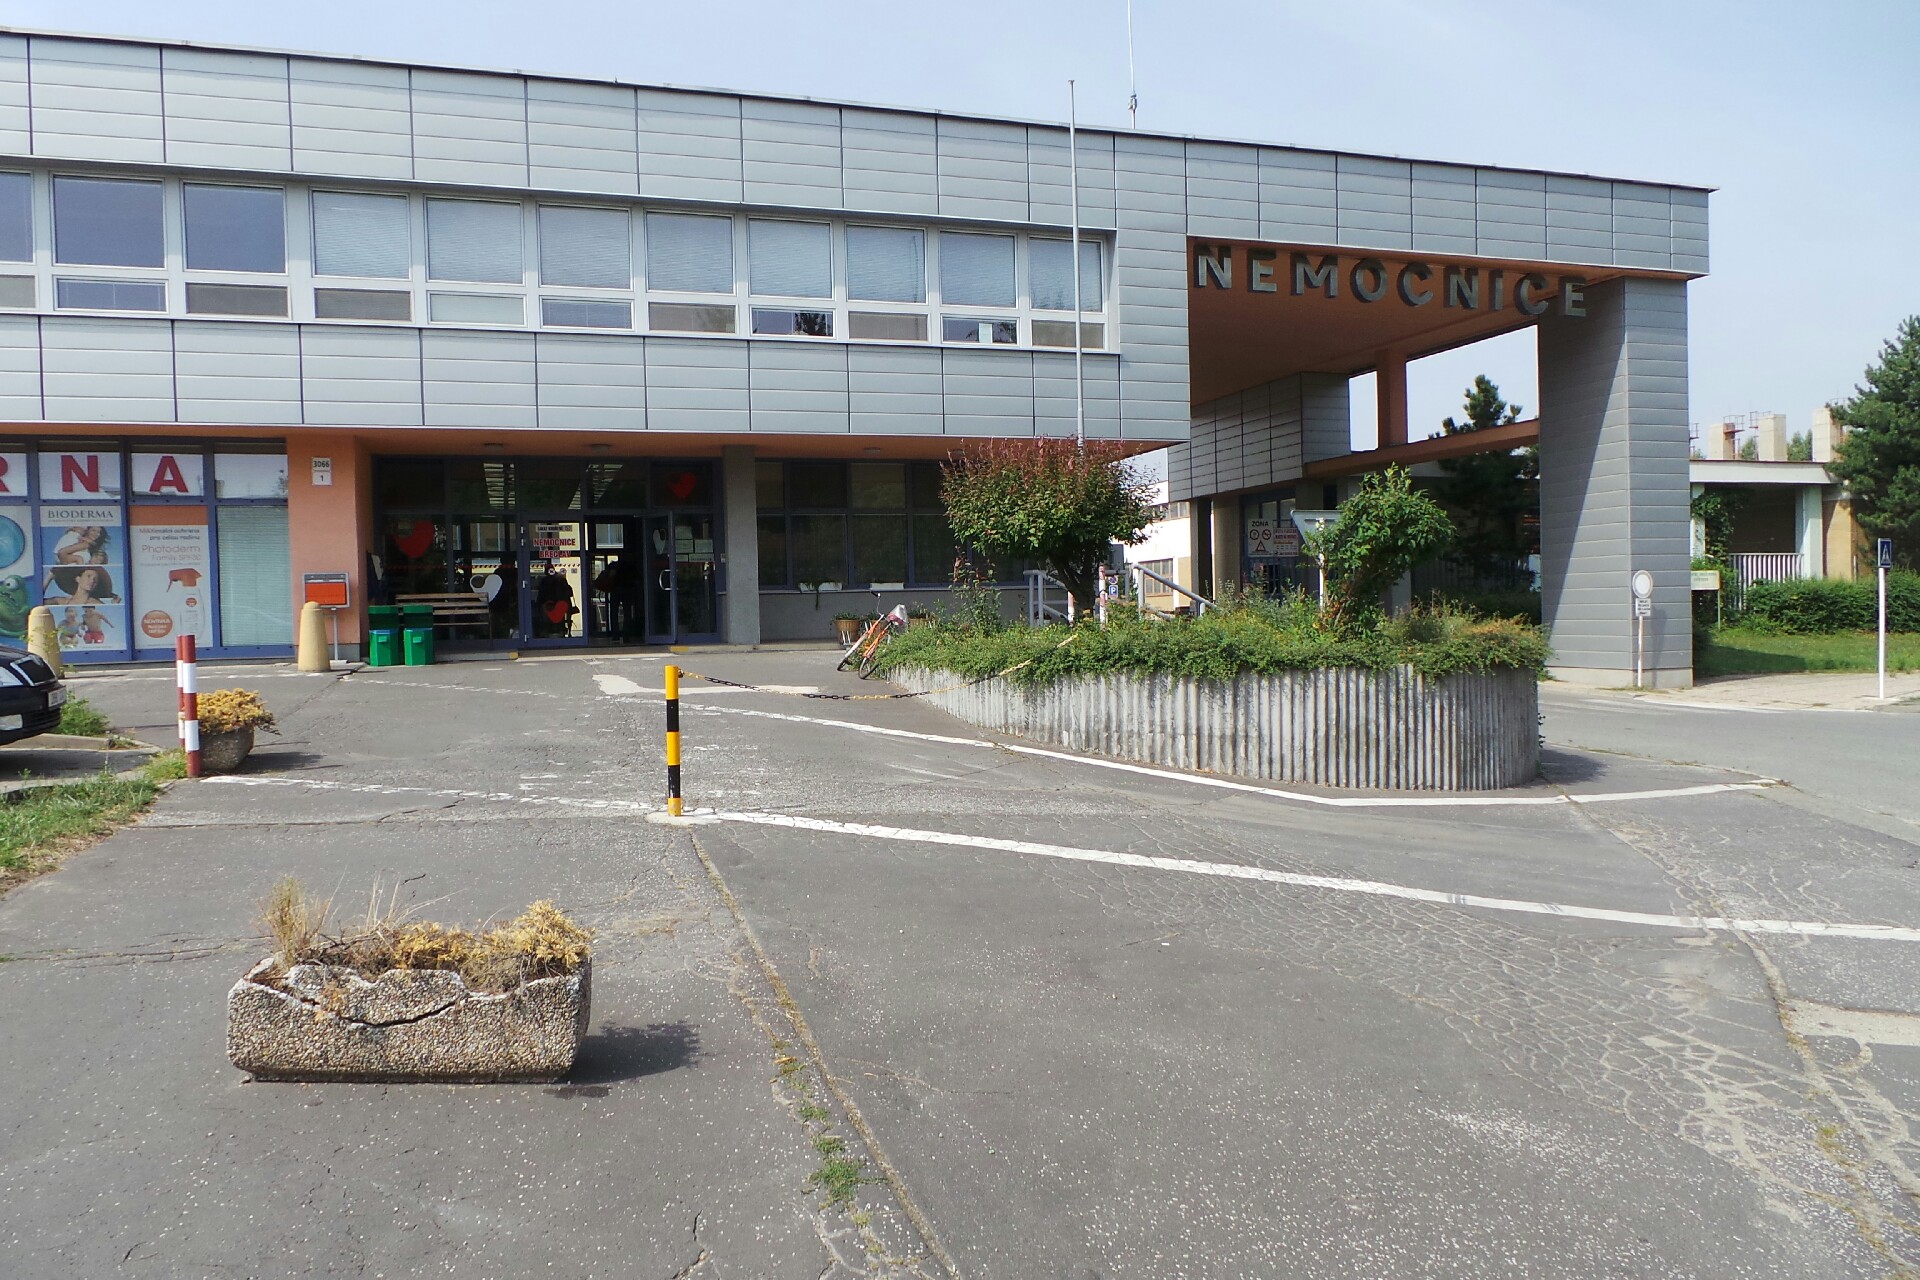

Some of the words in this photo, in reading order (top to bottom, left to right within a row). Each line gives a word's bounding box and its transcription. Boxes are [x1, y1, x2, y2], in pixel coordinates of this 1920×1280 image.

[1194, 246, 1587, 317] NEMOCNICE
[313, 460, 330, 468] 3066
[48, 510, 114, 519] BIODERMA
[533, 538, 576, 546] NEMOCNICE
[141, 544, 201, 553] Photoderm
